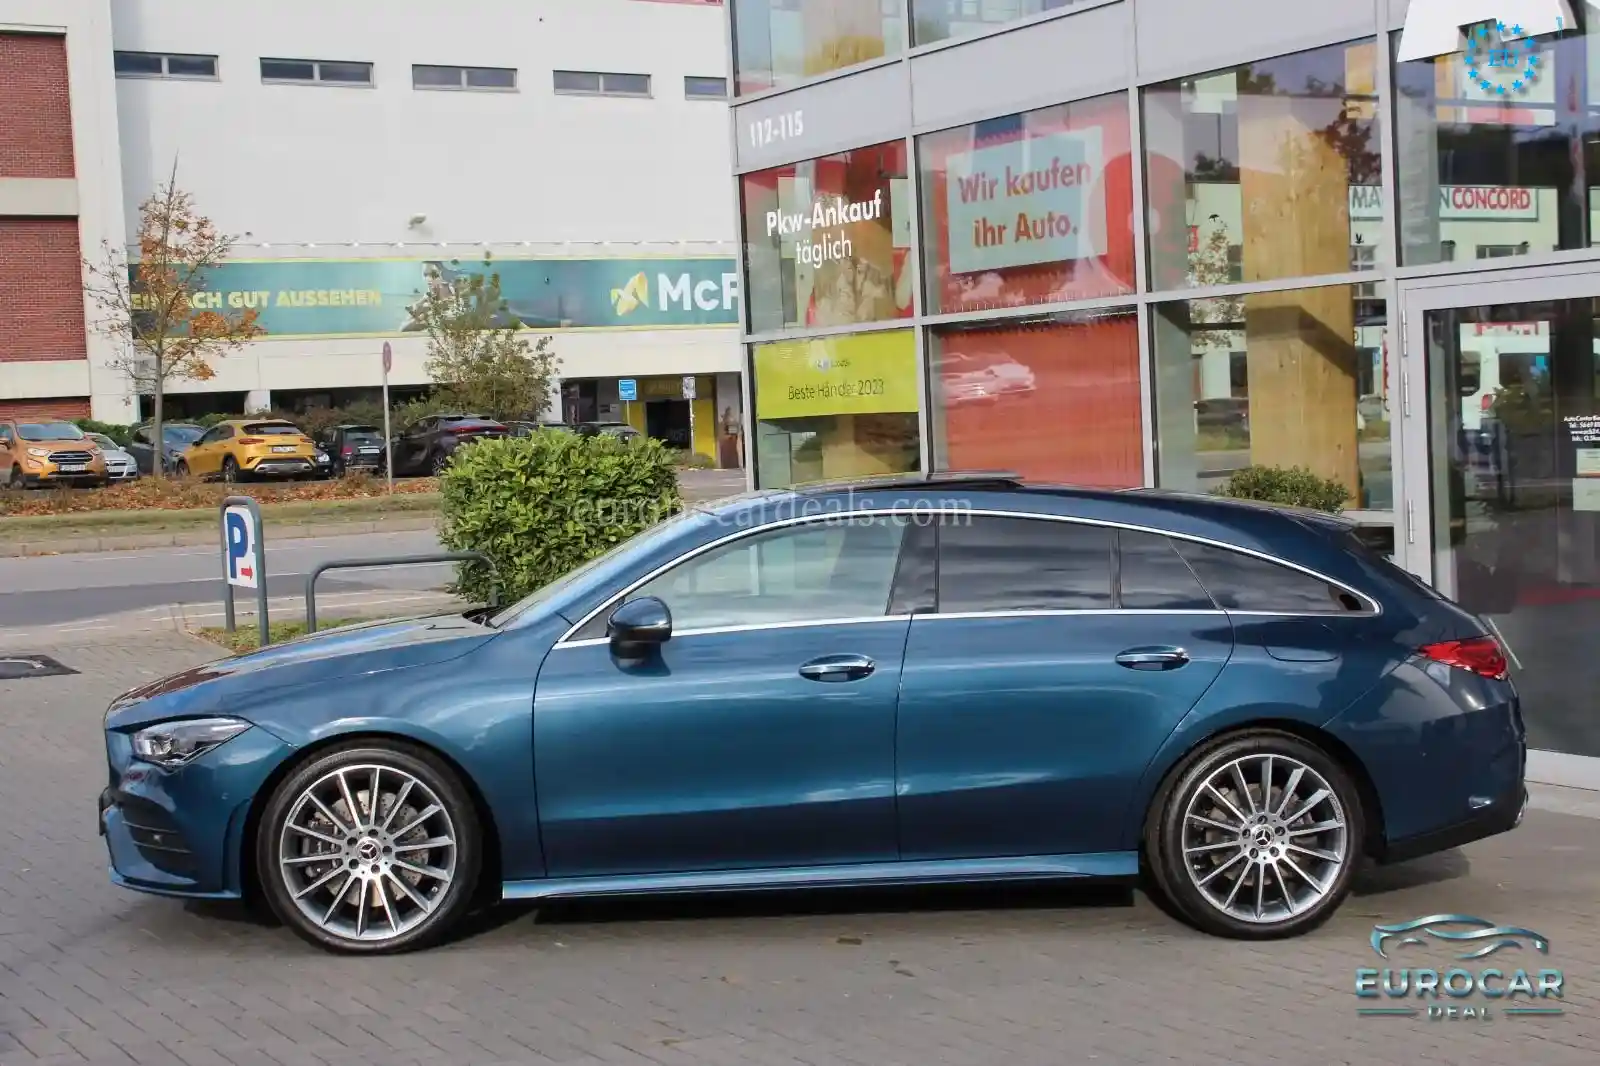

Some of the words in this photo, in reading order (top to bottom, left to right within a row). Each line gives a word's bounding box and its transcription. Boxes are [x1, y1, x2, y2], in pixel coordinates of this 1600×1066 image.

[750, 110, 804, 148] 112-115
[958, 172, 998, 204] Wir
[1005, 156, 1091, 197] kaufen
[1452, 187, 1531, 210] CONCORD
[766, 189, 882, 237] Pkw-Ankauf
[973, 217, 1008, 248] ihr
[1014, 211, 1078, 243] Auto.
[795, 230, 852, 269] täglich
[228, 291, 270, 309] GUT
[275, 289, 382, 308] AUSSEHEN
[788, 385, 815, 400] Beste
[857, 378, 884, 396] 2023
[226, 512, 249, 579] P
